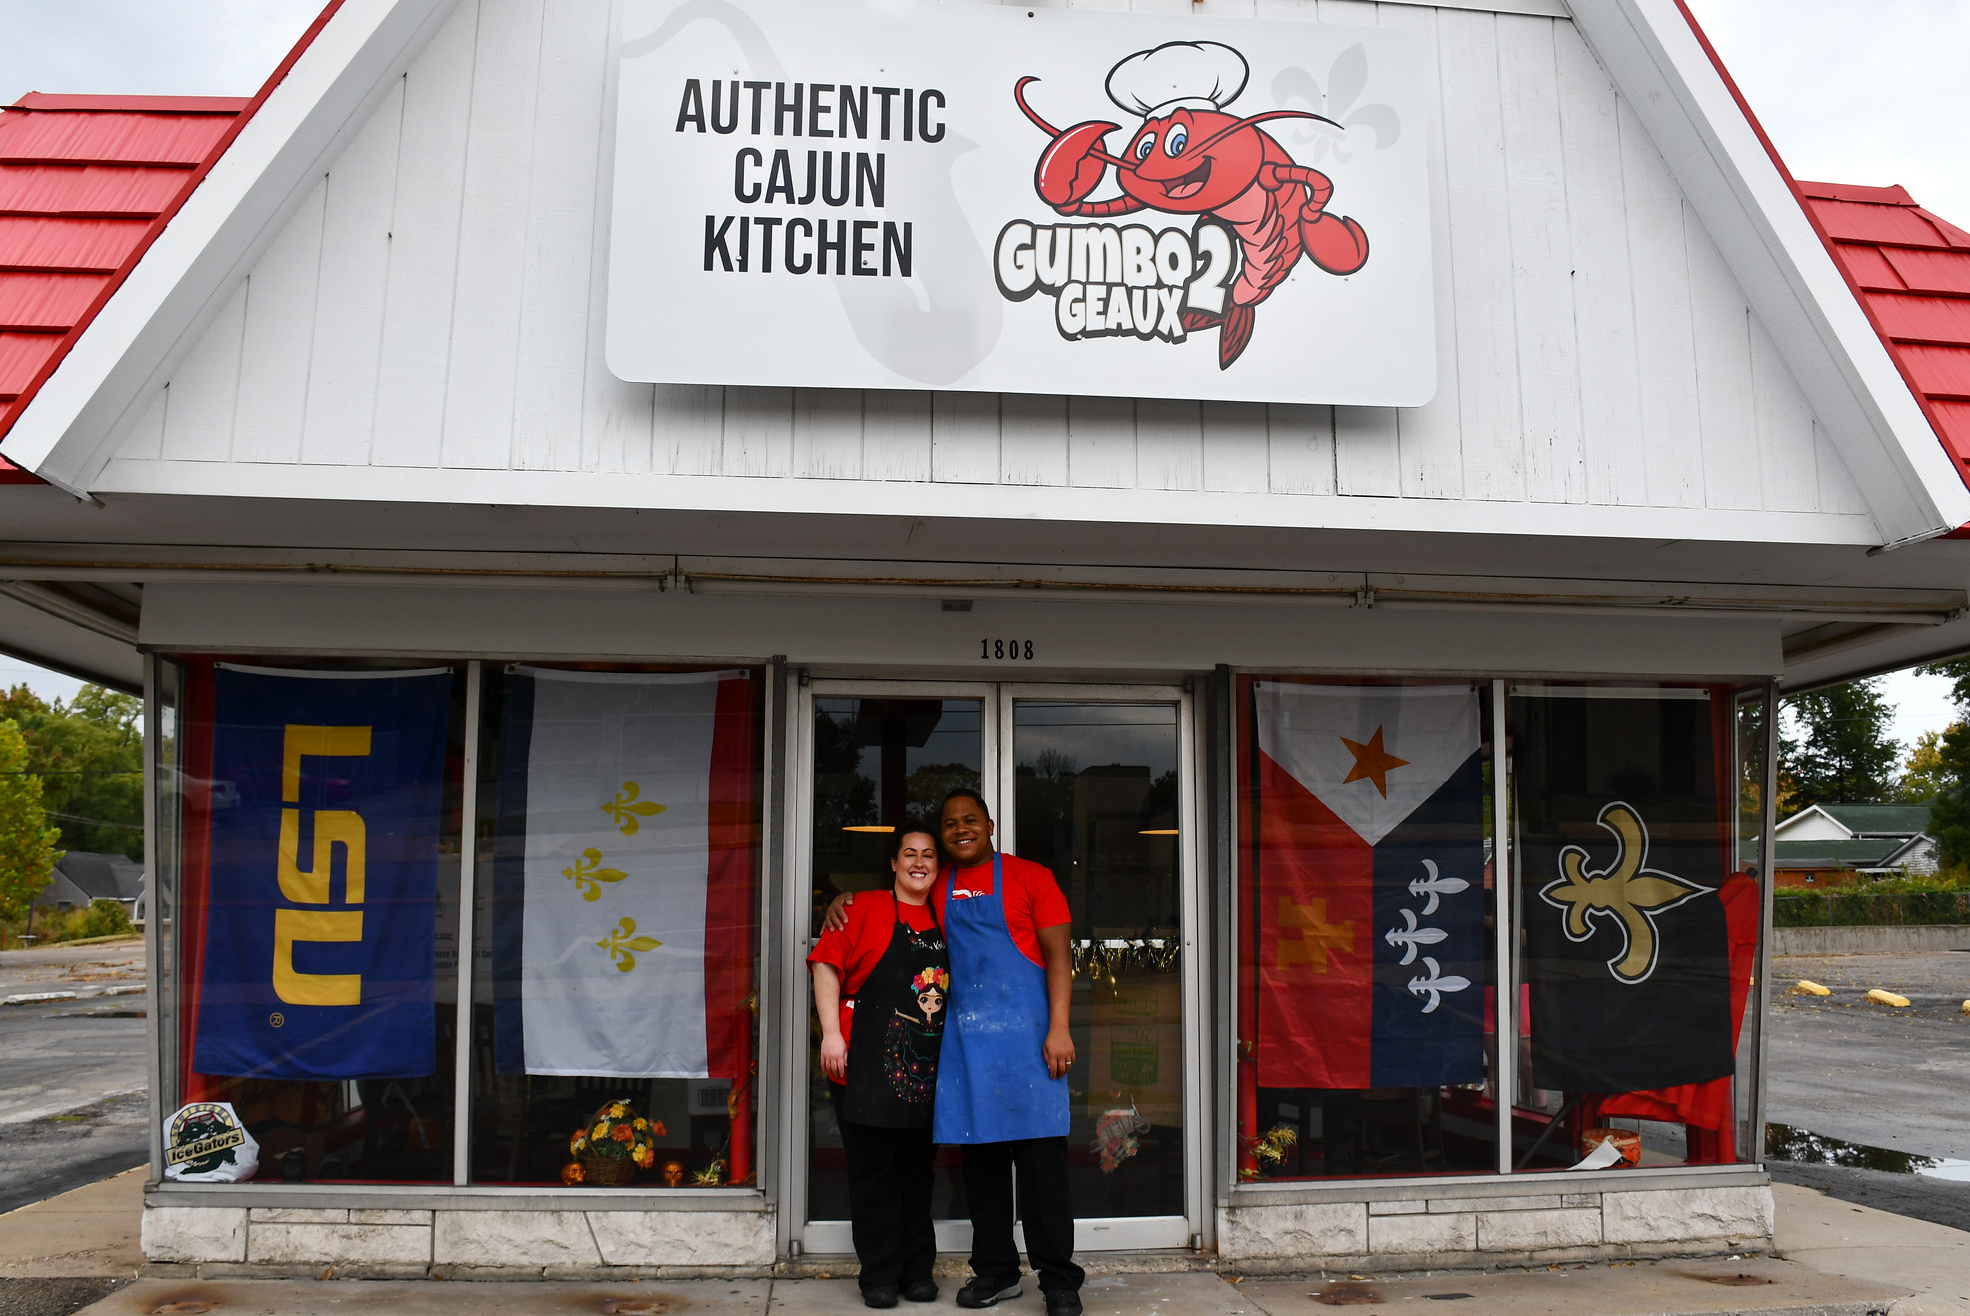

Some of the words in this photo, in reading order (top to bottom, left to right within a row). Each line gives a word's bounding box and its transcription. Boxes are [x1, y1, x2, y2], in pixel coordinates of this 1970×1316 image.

[676, 79, 945, 143] AUTHENTIC
[735, 148, 884, 208] CAJUN
[704, 216, 912, 277] KITCHEN
[1186, 223, 1232, 314] 2
[1057, 283, 1185, 338] GEAUX
[981, 639, 1034, 660] 1808
[272, 724, 372, 1006] LSU
